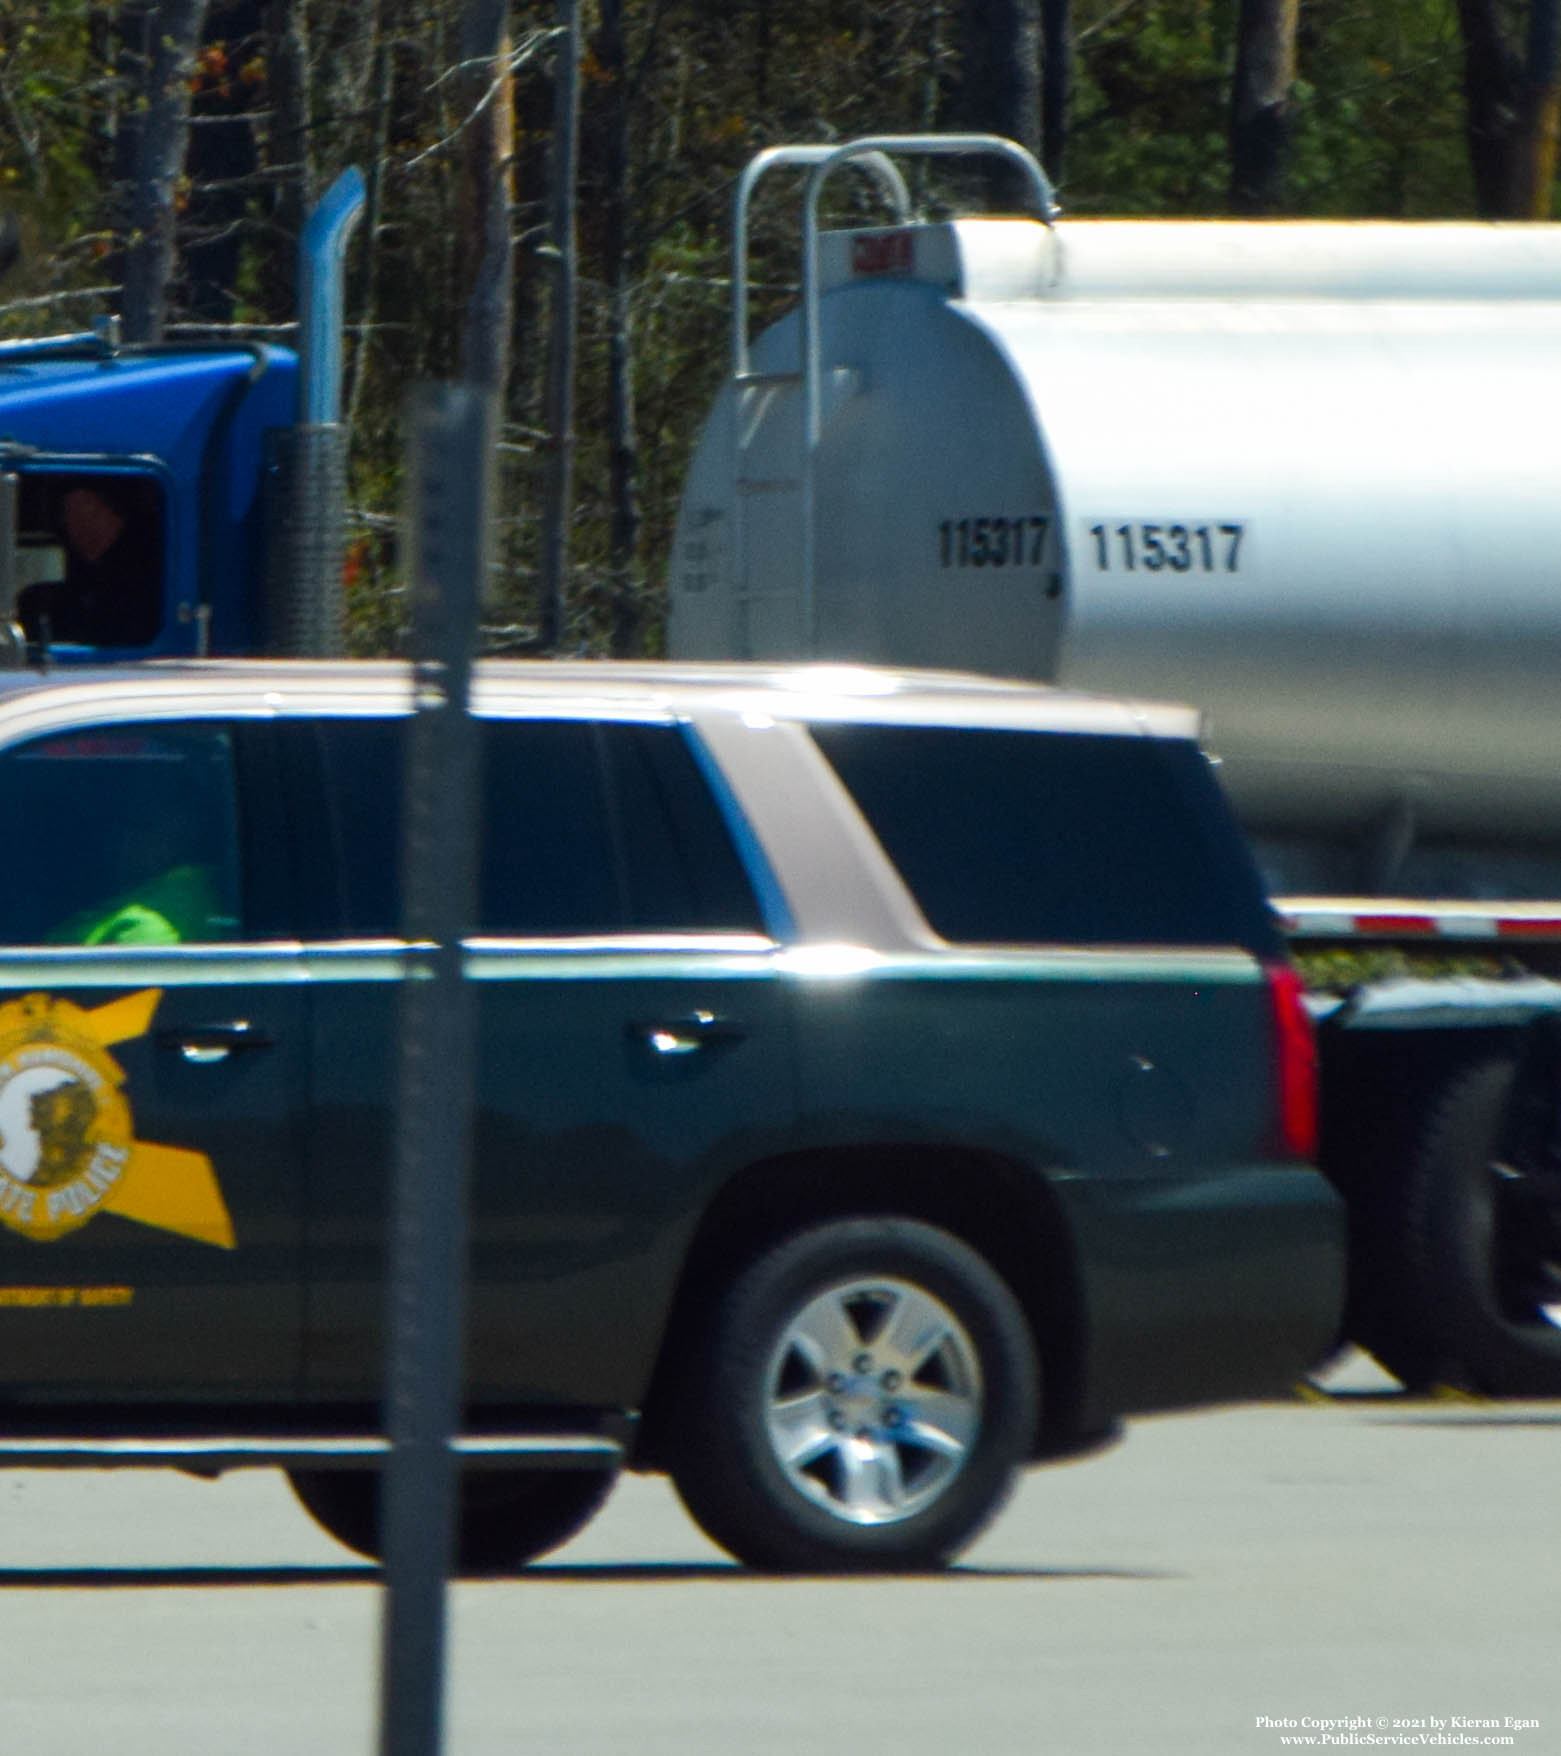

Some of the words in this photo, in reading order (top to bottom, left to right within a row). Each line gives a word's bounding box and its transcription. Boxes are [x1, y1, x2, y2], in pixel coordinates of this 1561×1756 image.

[937, 517, 1047, 567] 115317
[1090, 524, 1243, 572] 115317
[46, 1142, 131, 1223] POLICE
